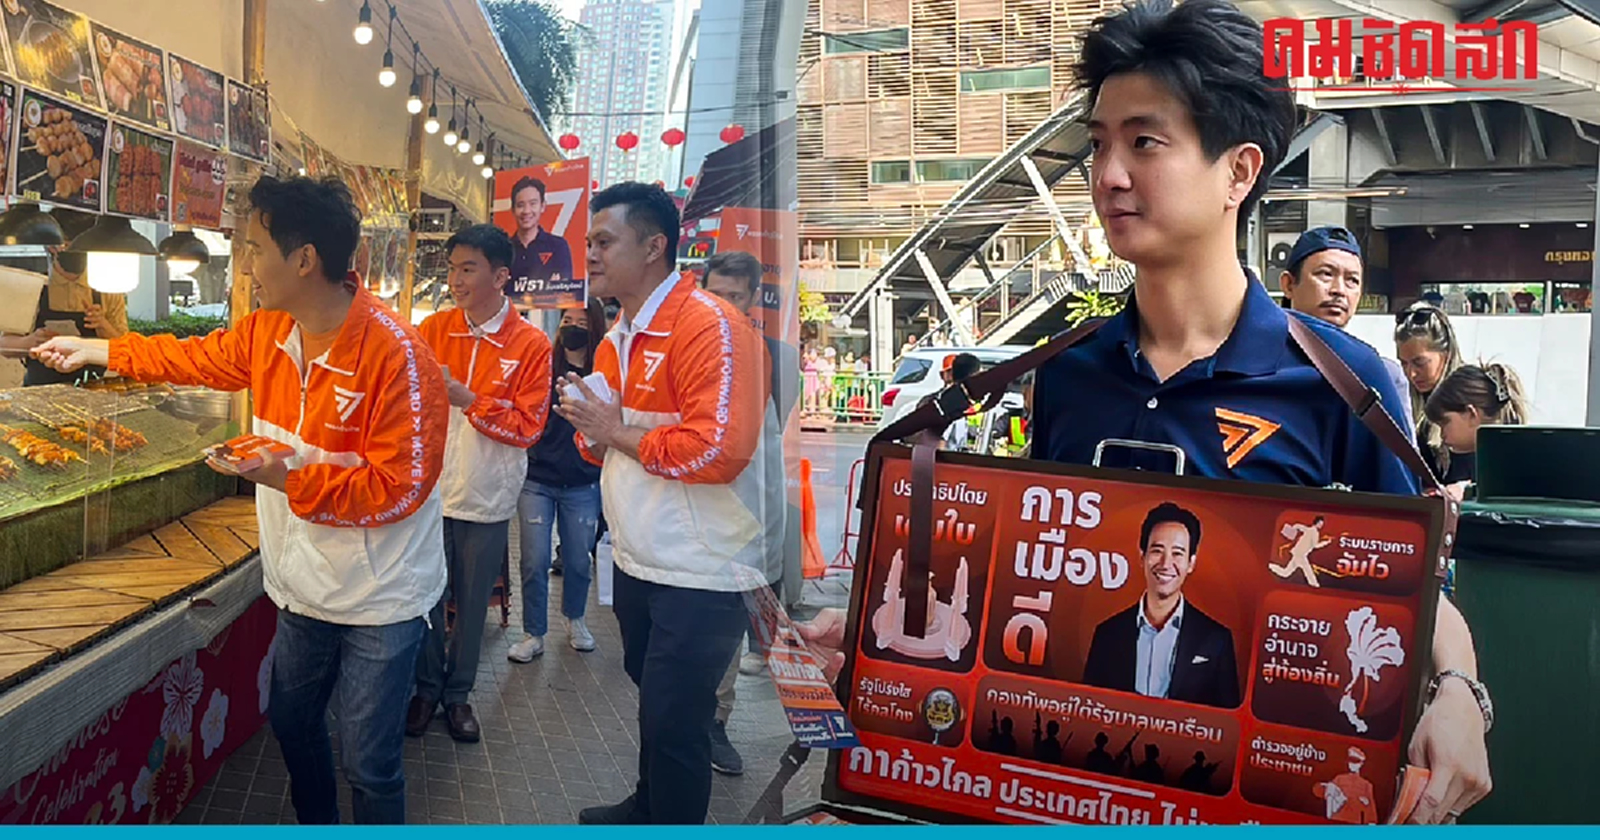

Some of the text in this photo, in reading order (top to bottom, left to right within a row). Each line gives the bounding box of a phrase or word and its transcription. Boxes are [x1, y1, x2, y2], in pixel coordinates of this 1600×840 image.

[373, 309, 423, 413] MOVE FORWARD
[715, 317, 733, 425] MOVE FORWARD
[411, 436, 425, 478] MOVE
[893, 478, 988, 505] ปราธิปไตย
[1020, 485, 1102, 529] การ
[1013, 528, 1130, 590] เมือง
[1339, 536, 1415, 555] ระบบราชการ
[1336, 551, 1390, 579] ฉับไว
[1002, 590, 1053, 666] ดี
[1268, 614, 1331, 636] กระจาย
[1264, 632, 1318, 658] อำนาจ
[1262, 656, 1341, 686] สู่ท้องถิ่น
[859, 676, 912, 698] รัฐโปร่งใส
[857, 696, 914, 722] ไร้กลโกง
[986, 688, 1223, 743] กองทัพอยู่ใต้รัฐบาลพลเรือน
[1251, 735, 1327, 762] ตำรวจอยู่ข้าง
[1249, 752, 1314, 778] ประชาชน
[849, 746, 993, 799] กาก้าวไกล
[998, 779, 1151, 825] ประเทศไทย
